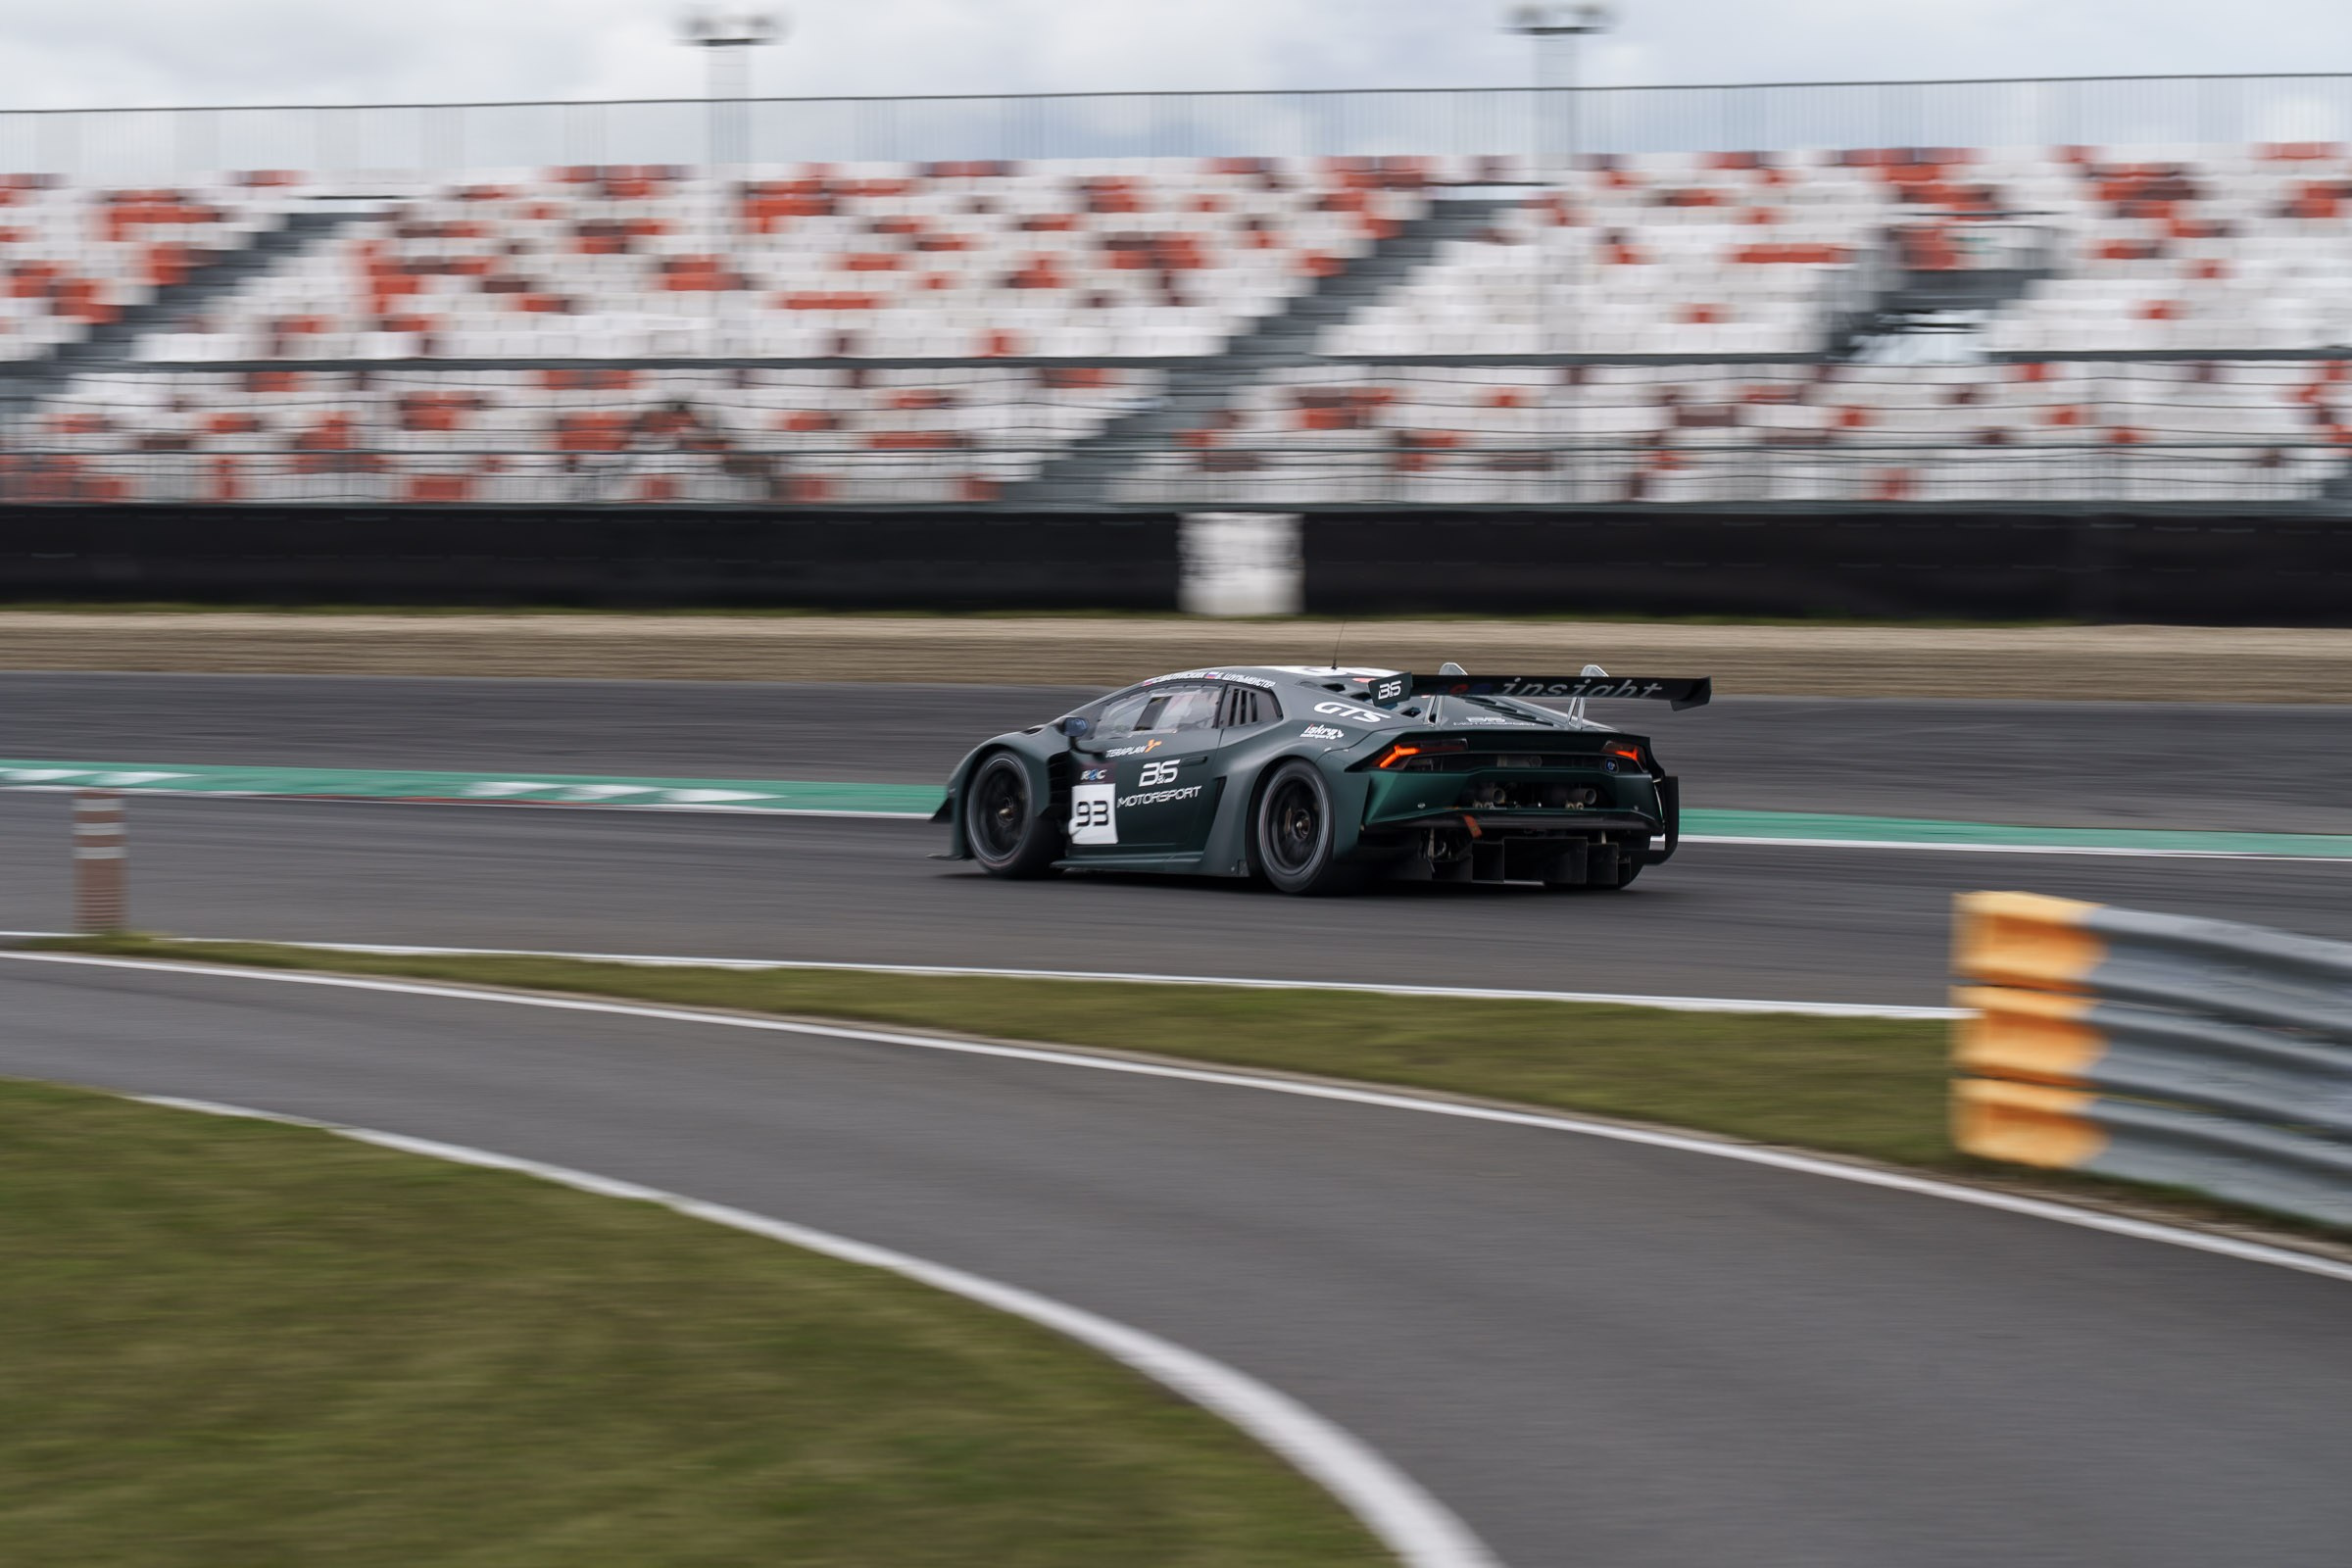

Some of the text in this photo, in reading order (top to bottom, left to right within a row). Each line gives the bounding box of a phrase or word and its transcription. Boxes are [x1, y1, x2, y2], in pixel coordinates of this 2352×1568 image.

[1499, 677, 1663, 699] insight
[1313, 702, 1393, 723] GTS
[1116, 785, 1202, 808] MOTORSPORT
[1075, 800, 1109, 827] 93
